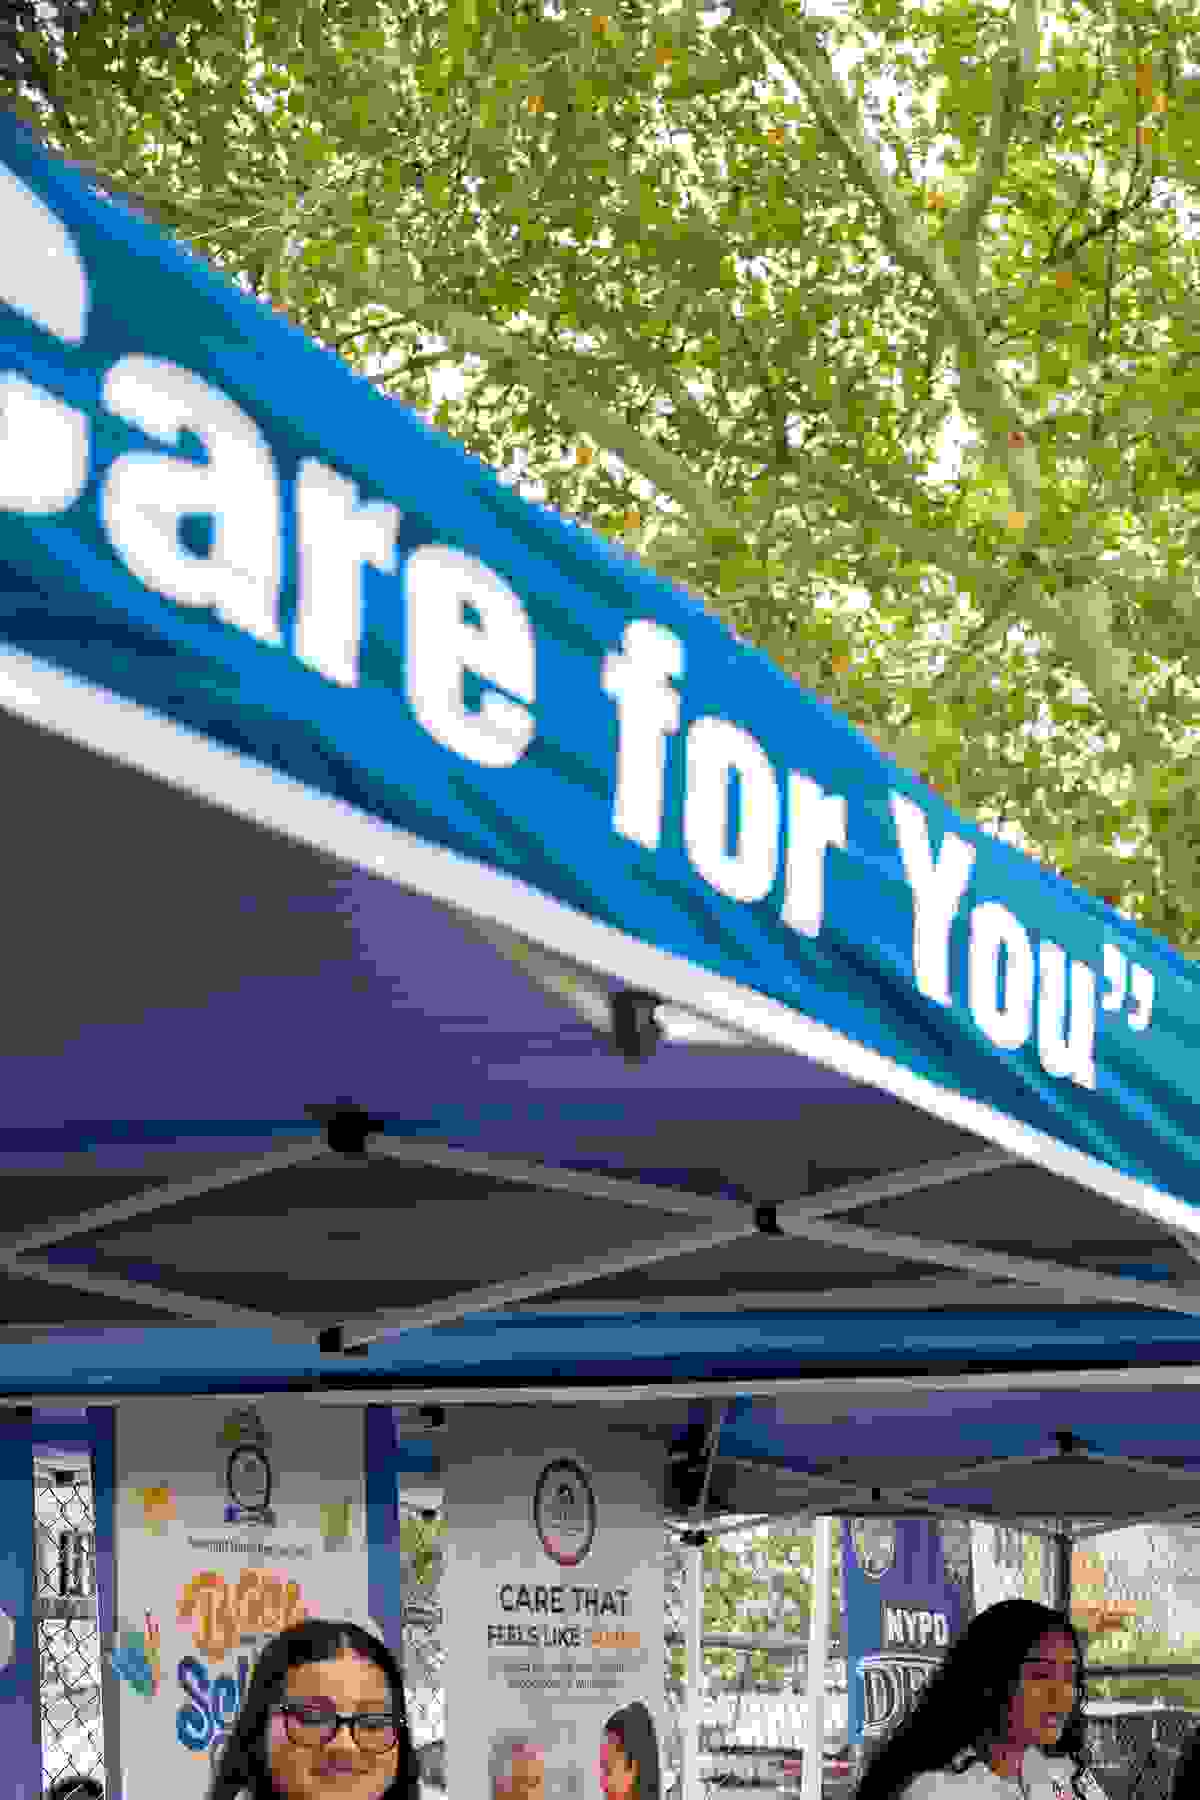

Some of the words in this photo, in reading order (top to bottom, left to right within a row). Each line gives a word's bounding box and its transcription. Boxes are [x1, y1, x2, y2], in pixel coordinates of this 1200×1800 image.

[602, 619, 848, 939] for
[499, 1584, 566, 1614] CARE
[570, 1587, 629, 1617] THAT
[486, 1625, 541, 1648] FEELS
[544, 1625, 582, 1649] LIKE
[887, 1607, 950, 1647] NYPD
